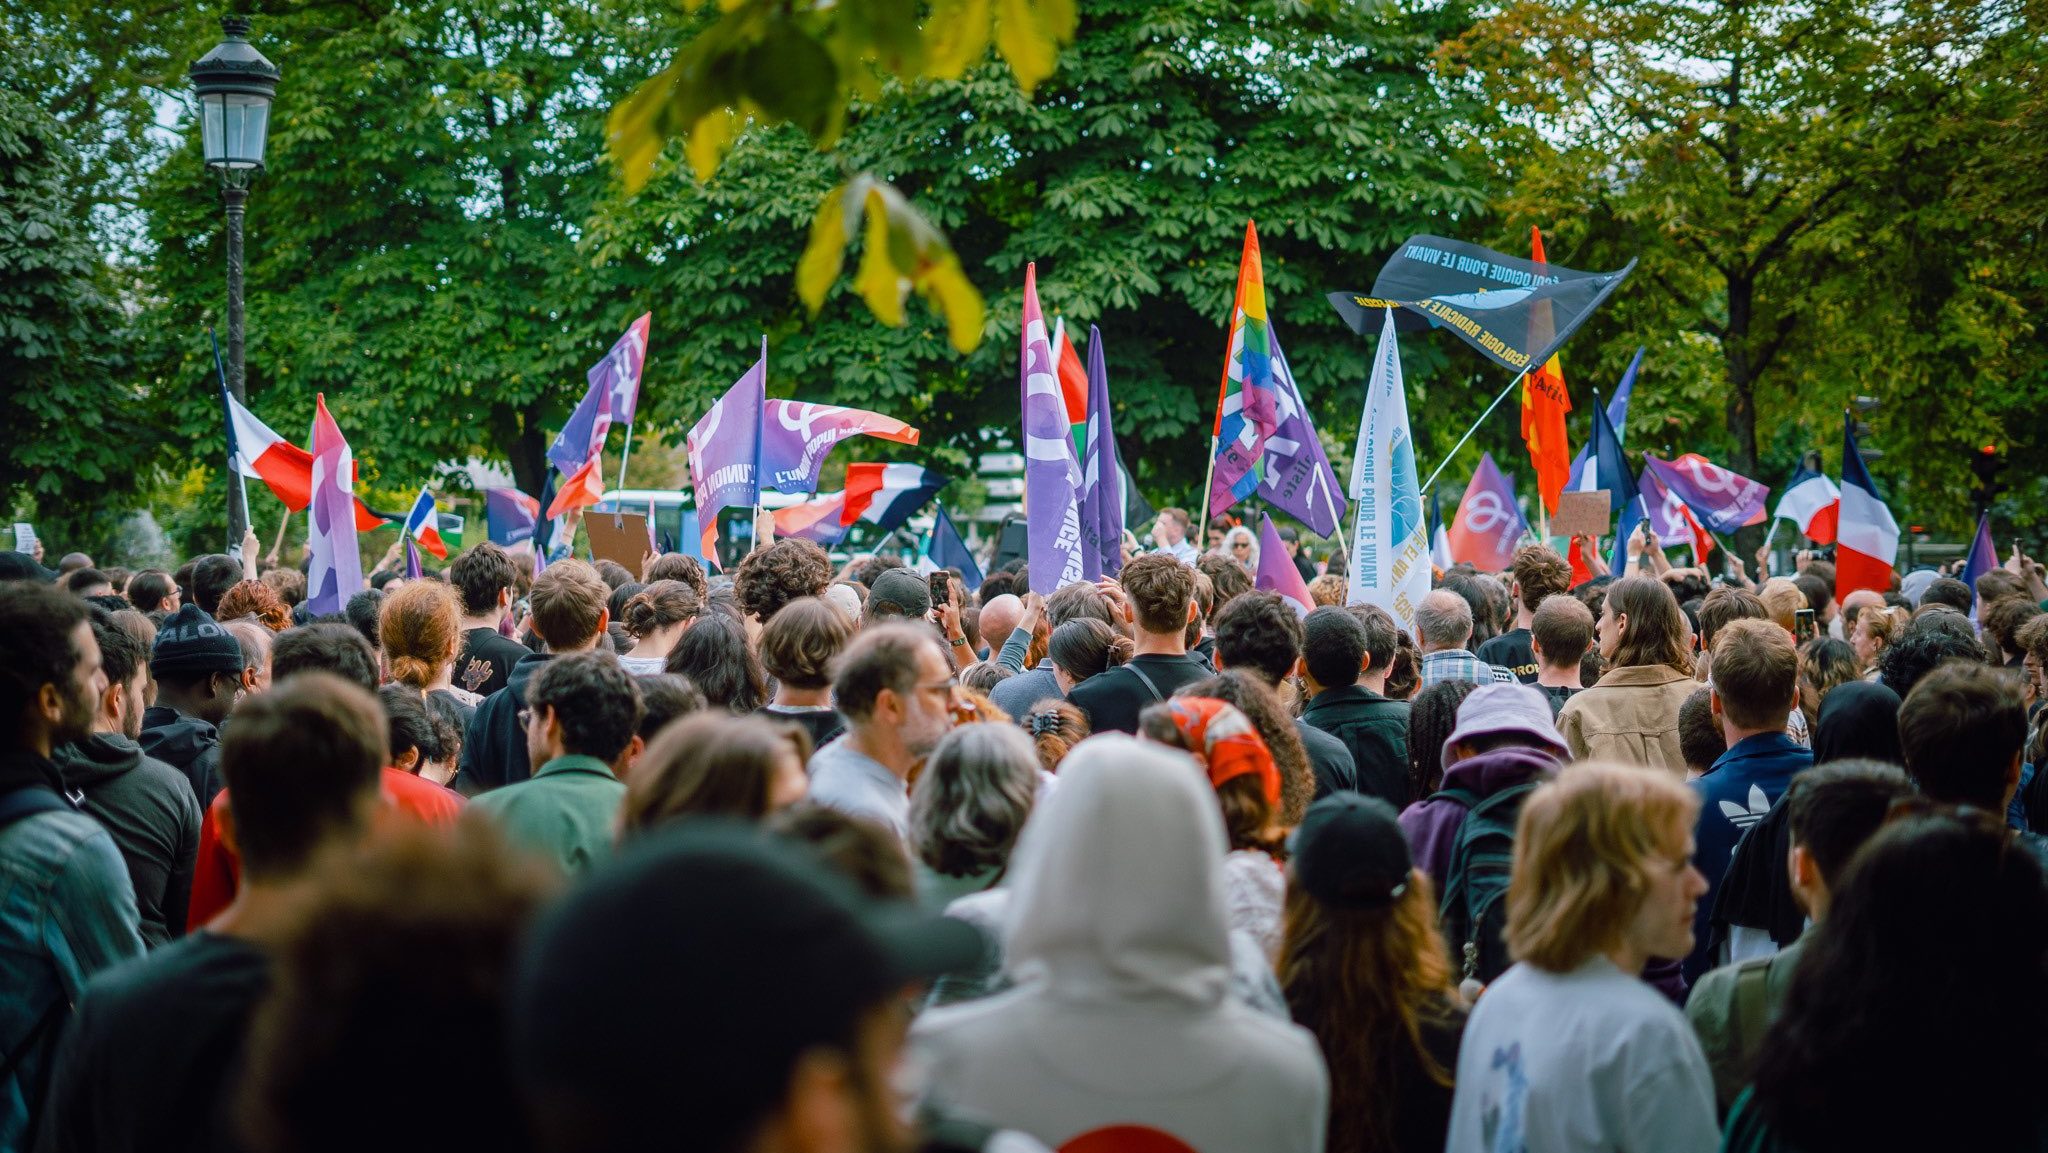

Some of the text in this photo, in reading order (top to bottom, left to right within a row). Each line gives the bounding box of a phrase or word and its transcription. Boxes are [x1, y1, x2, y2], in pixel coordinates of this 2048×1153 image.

[1361, 488, 1377, 522] POUR
[1361, 525, 1377, 540] LE
[1361, 543, 1378, 589] VIVANT
